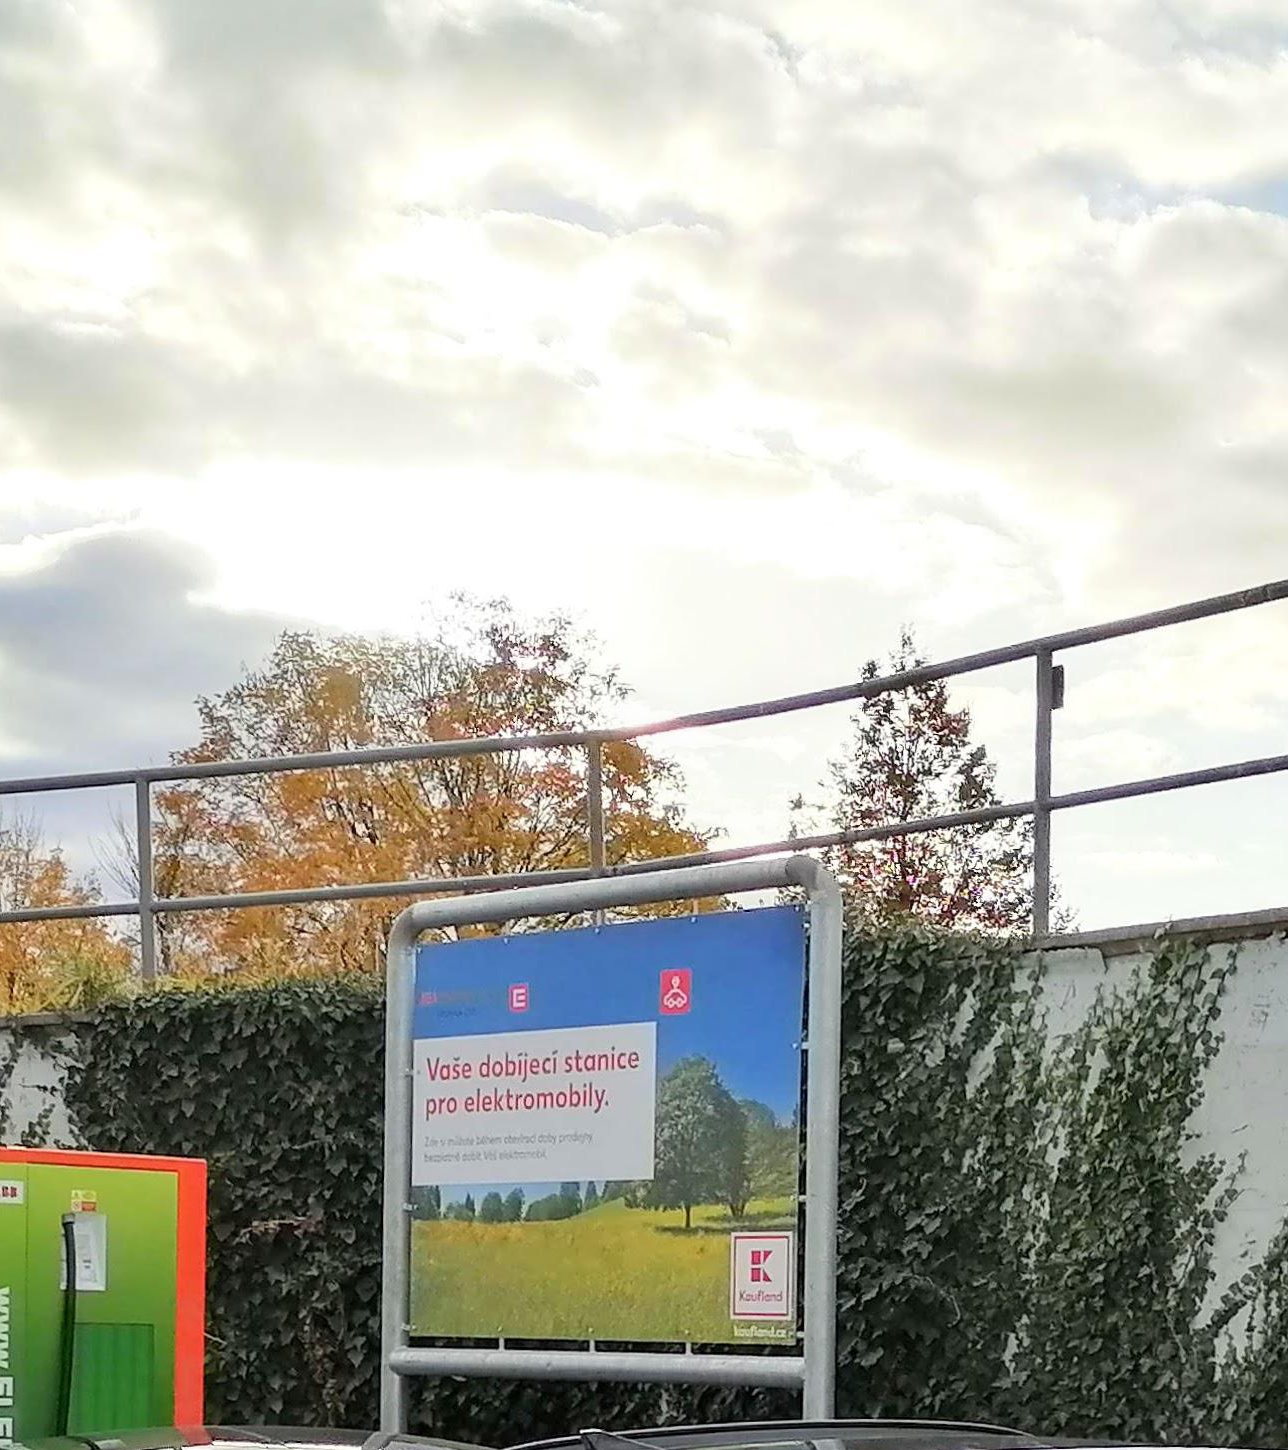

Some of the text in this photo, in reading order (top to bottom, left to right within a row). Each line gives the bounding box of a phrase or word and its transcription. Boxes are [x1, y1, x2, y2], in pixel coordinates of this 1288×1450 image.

[426, 1046, 640, 1083] Vaše dobíjecí stanice
[425, 1081, 609, 1121] pro elektromobily.
[739, 1290, 783, 1302] Kaufland
